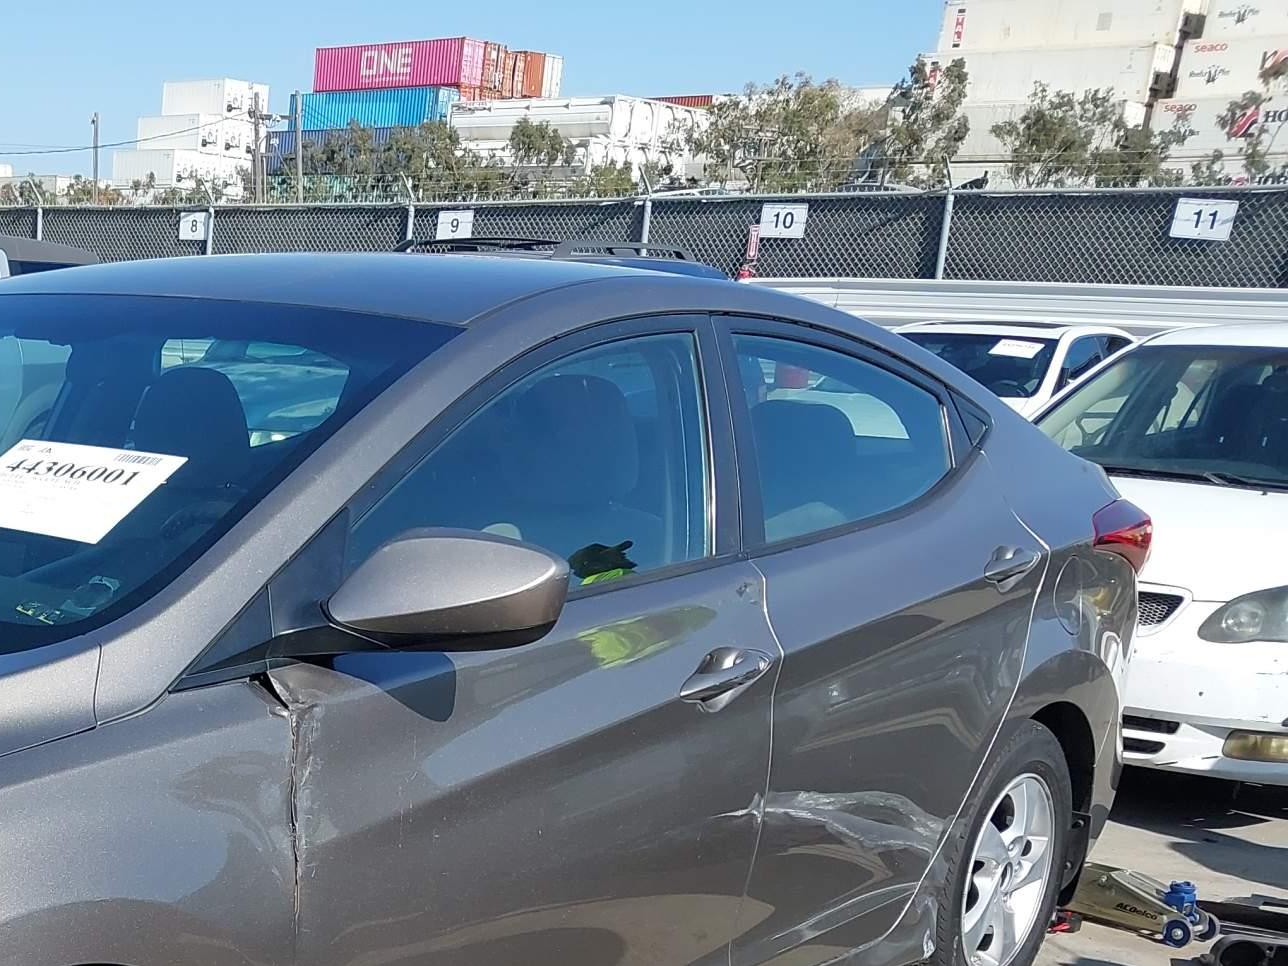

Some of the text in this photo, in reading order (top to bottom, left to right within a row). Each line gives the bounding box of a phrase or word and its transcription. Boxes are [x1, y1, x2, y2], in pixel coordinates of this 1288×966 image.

[1194, 43, 1228, 53] seaco
[360, 48, 412, 76] ONE
[1164, 103, 1197, 113] seaco
[190, 219, 198, 233] 8
[450, 217, 460, 233] 9
[772, 211, 795, 229] 10
[1193, 208, 1219, 230] 11
[5, 458, 141, 486] 44306001
[1113, 902, 1159, 921] ACDelco
